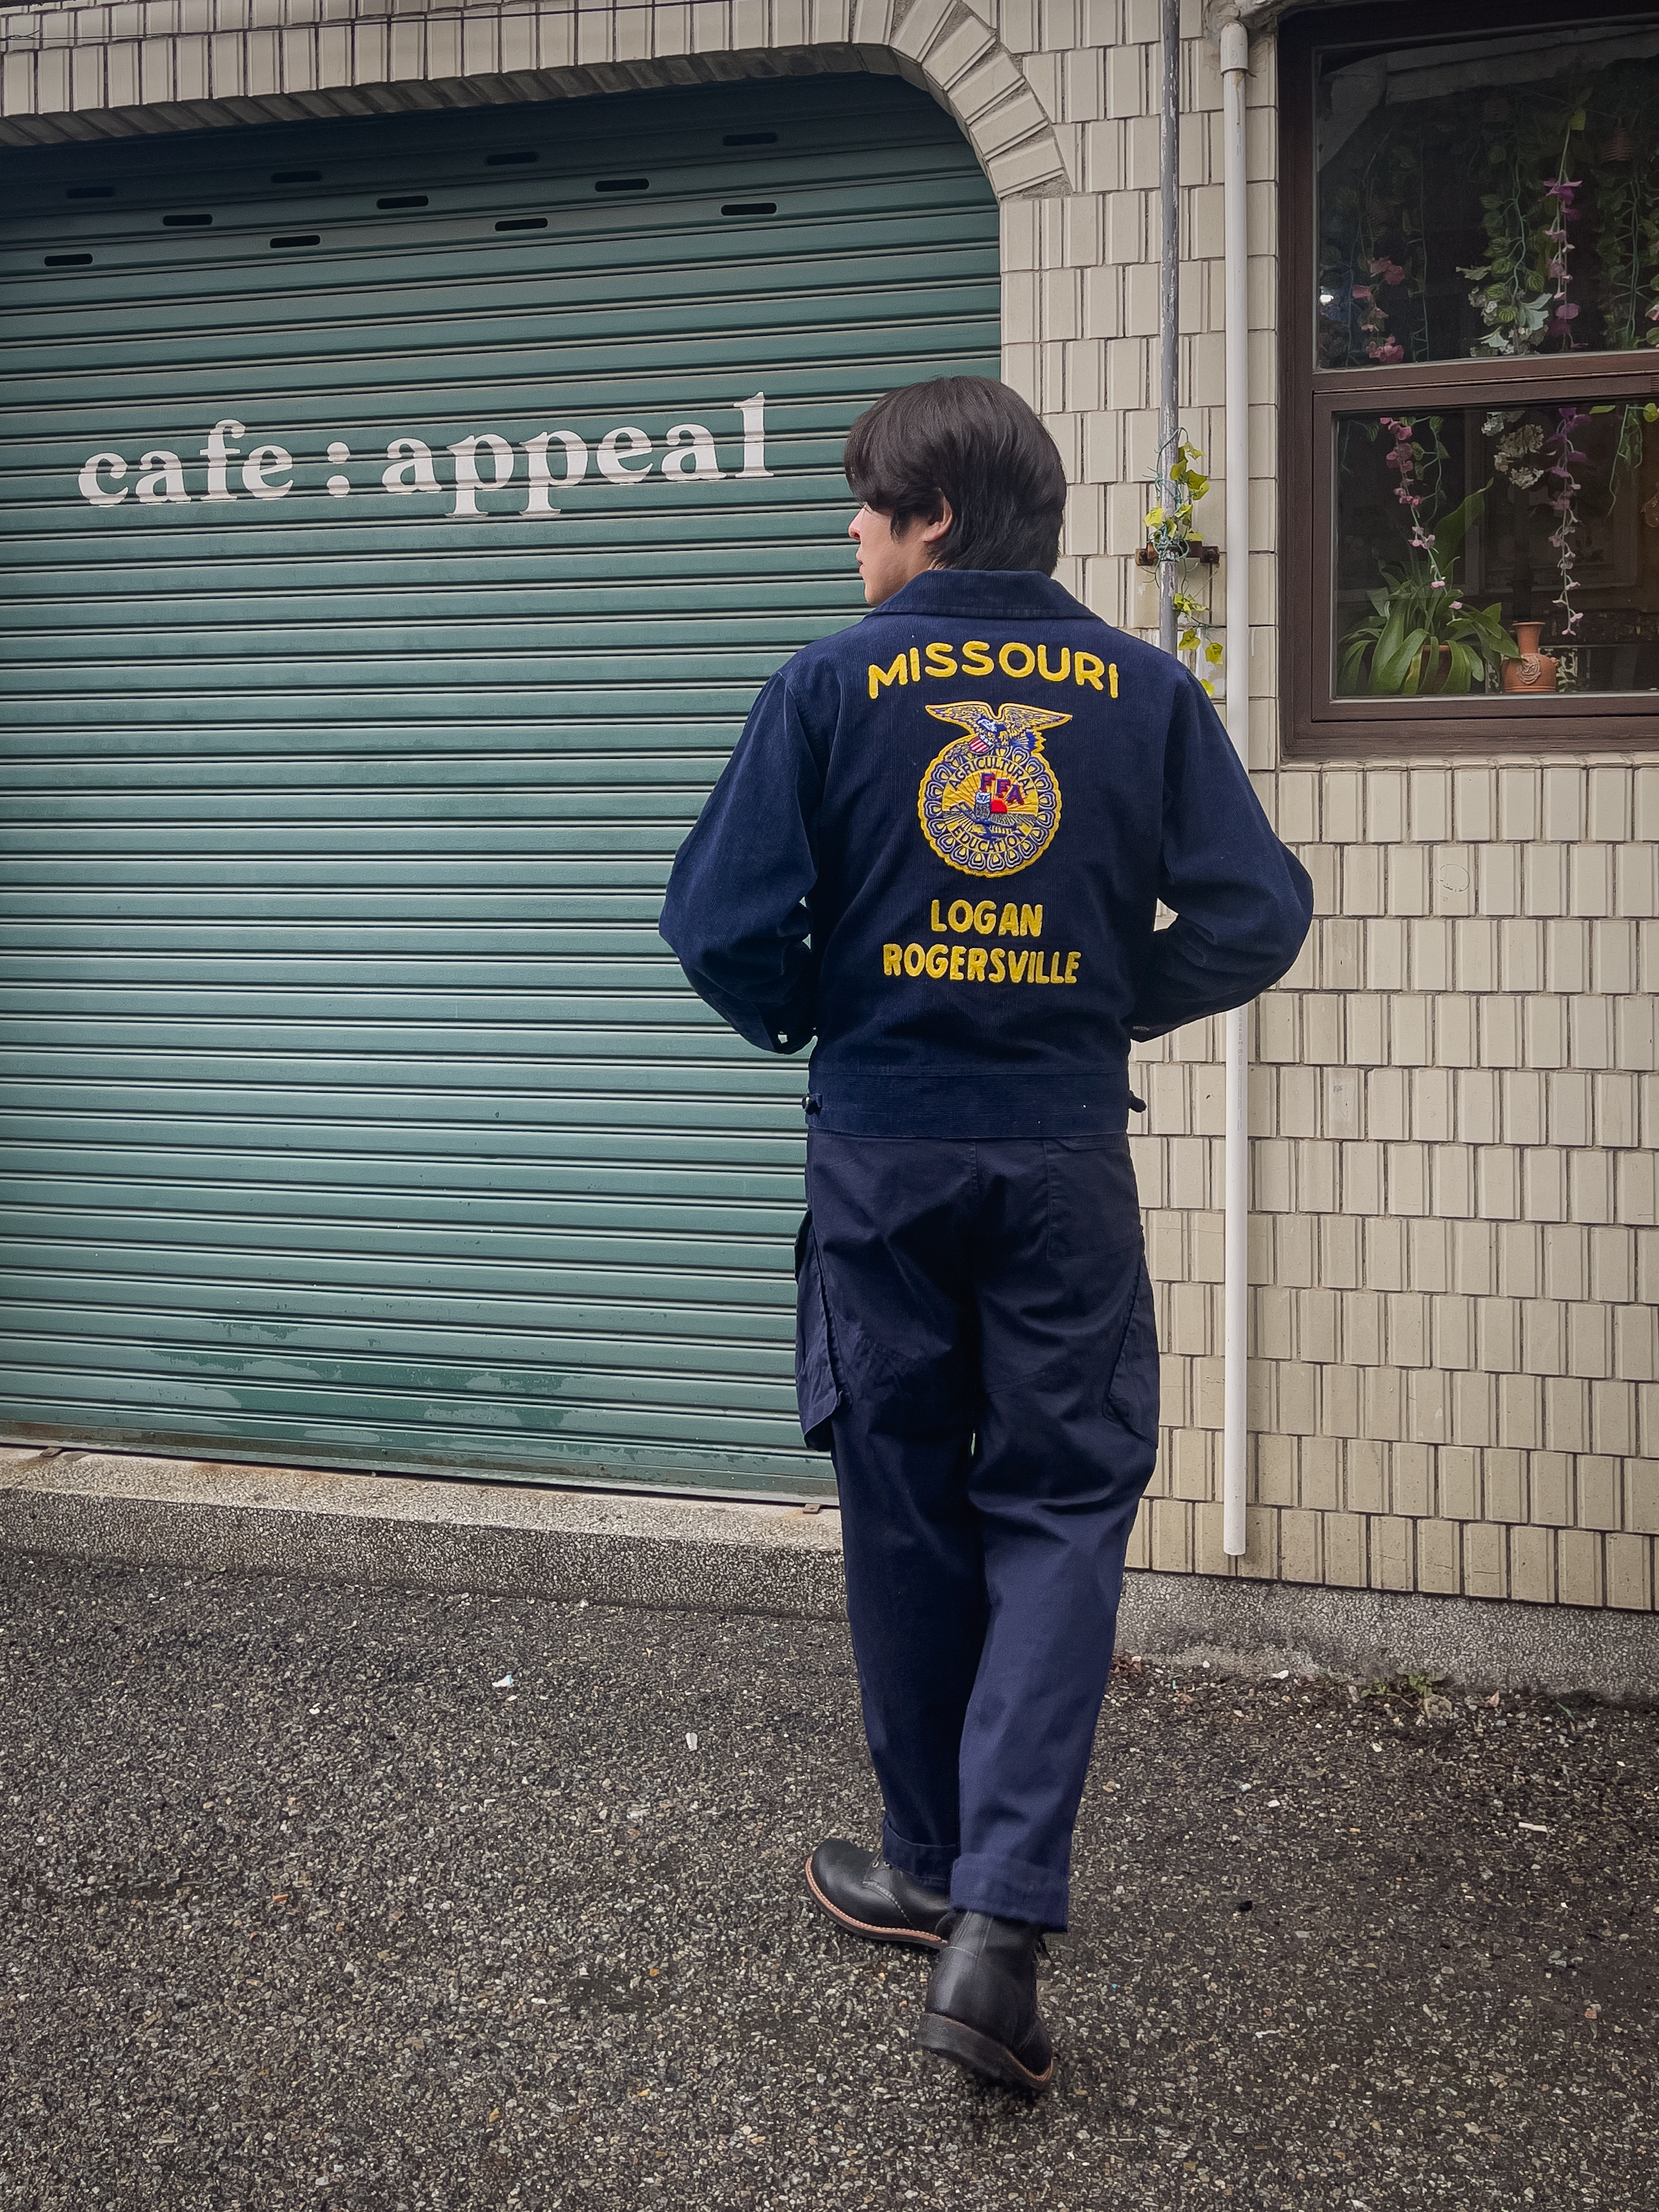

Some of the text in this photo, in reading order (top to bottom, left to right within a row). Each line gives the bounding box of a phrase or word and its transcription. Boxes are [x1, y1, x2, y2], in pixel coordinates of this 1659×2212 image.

[78, 392, 774, 518] cafe : appeal
[868, 640, 1119, 700] MISSOURI
[948, 756, 1035, 796] AGRICULTURAL
[980, 772, 1025, 805] FFA
[952, 824, 1027, 853] EDUCATION
[931, 899, 1043, 937] LOGAN
[883, 943, 1081, 984] ROGERSVILLE
